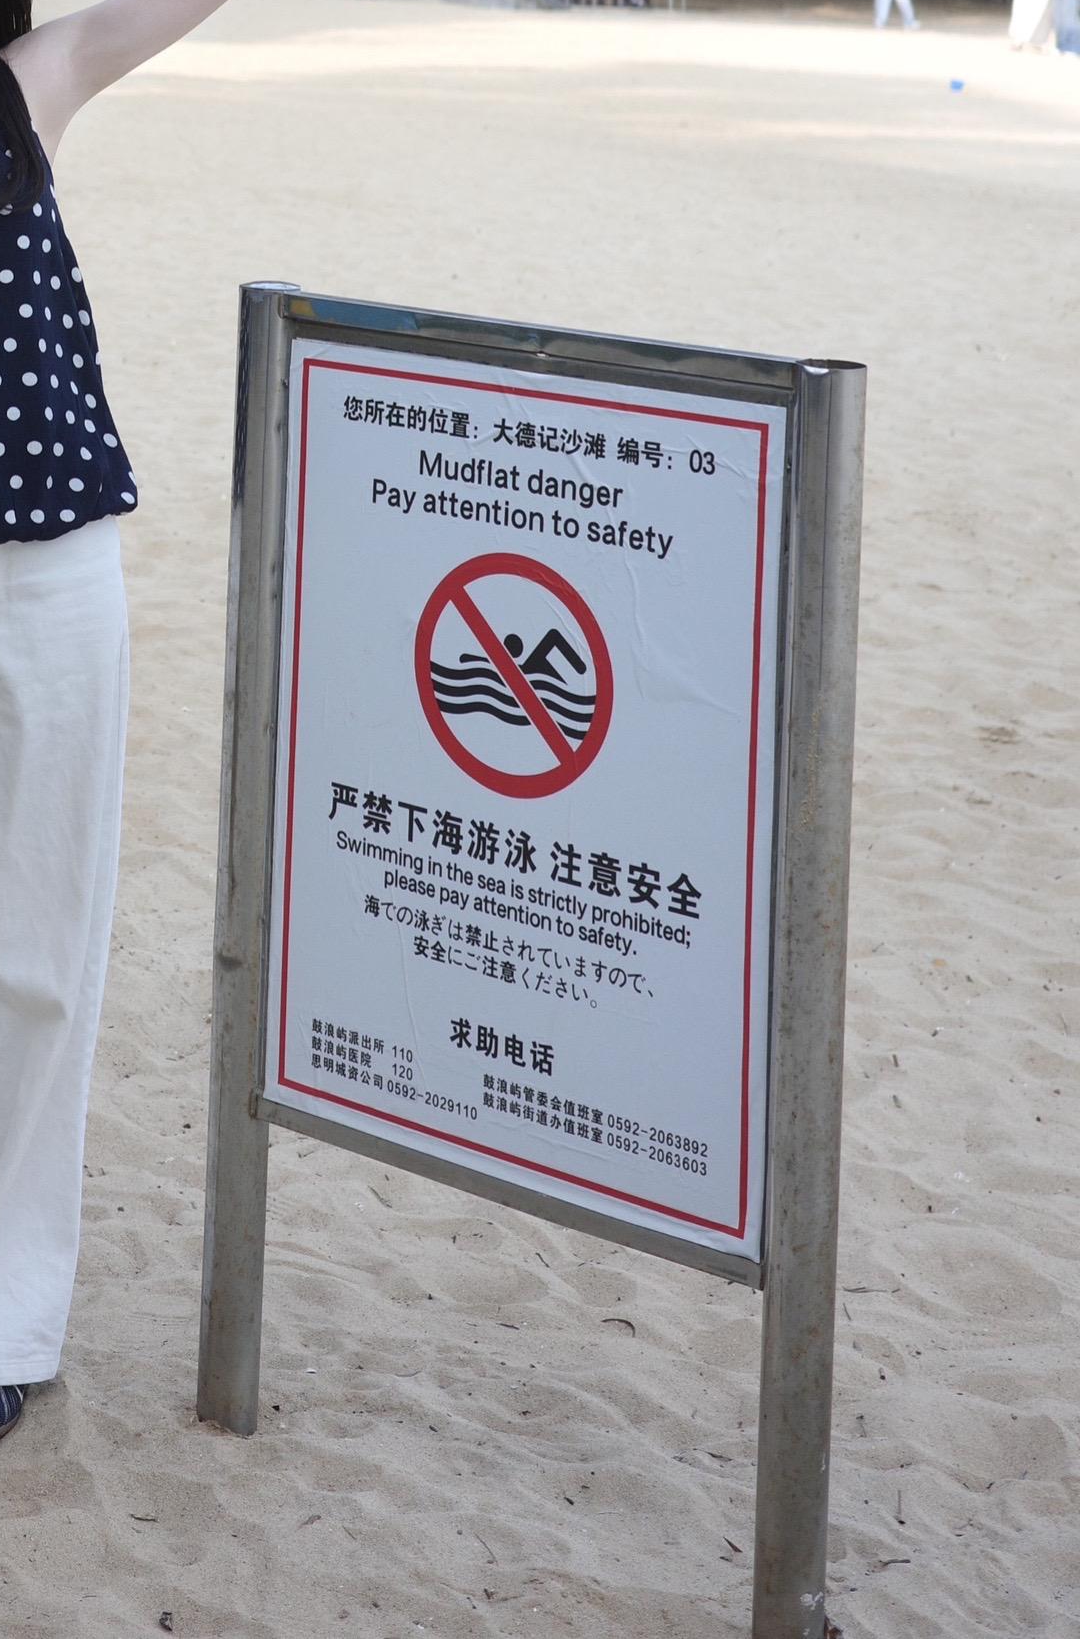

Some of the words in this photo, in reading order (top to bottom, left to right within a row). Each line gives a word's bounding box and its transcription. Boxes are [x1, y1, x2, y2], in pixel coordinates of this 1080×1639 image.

[343, 395, 479, 439] 您所在的位置：
[493, 418, 607, 461] 大德记沙滩
[617, 437, 673, 471] 编号：
[689, 449, 716, 476] 03
[372, 478, 417, 515] Pay
[423, 490, 545, 533] attention
[552, 510, 580, 539] to
[587, 521, 674, 560] safety
[420, 449, 521, 492] Mudflat
[527, 469, 624, 510] danger
[328, 781, 537, 875] 严禁下海游泳
[550, 841, 703, 920] 注意安全
[336, 830, 424, 876] Swimming
[427, 856, 443, 878] in
[446, 862, 474, 886] the
[477, 874, 506, 896] sea
[511, 879, 525, 901] is
[528, 887, 587, 921] strictly
[591, 905, 691, 950] prohibited;
[364, 894, 654, 998] 海での泳ぎは禁止されていますので、
[384, 870, 436, 899] please
[439, 887, 470, 912] pay
[473, 895, 552, 932] attention
[555, 916, 575, 938] to
[578, 925, 638, 957] safety.
[413, 935, 598, 1009] 安全にご注意ください。
[311, 1036, 372, 1069] 鼓浪屿医院
[391, 1063, 414, 1081] 120
[312, 1018, 385, 1055] 鼓浪屿派出所
[391, 1045, 414, 1064] 110
[449, 1017, 555, 1077] 求助电话
[311, 1053, 384, 1091] 思明城资公司
[387, 1079, 478, 1121] 0592-2029110
[483, 1073, 604, 1126] 鼓浪屿管委会值班室
[607, 1113, 708, 1158] 0592-2063892
[482, 1092, 604, 1145] 鼓浪屿街道办值班室
[606, 1132, 708, 1177] 0592-2063603
